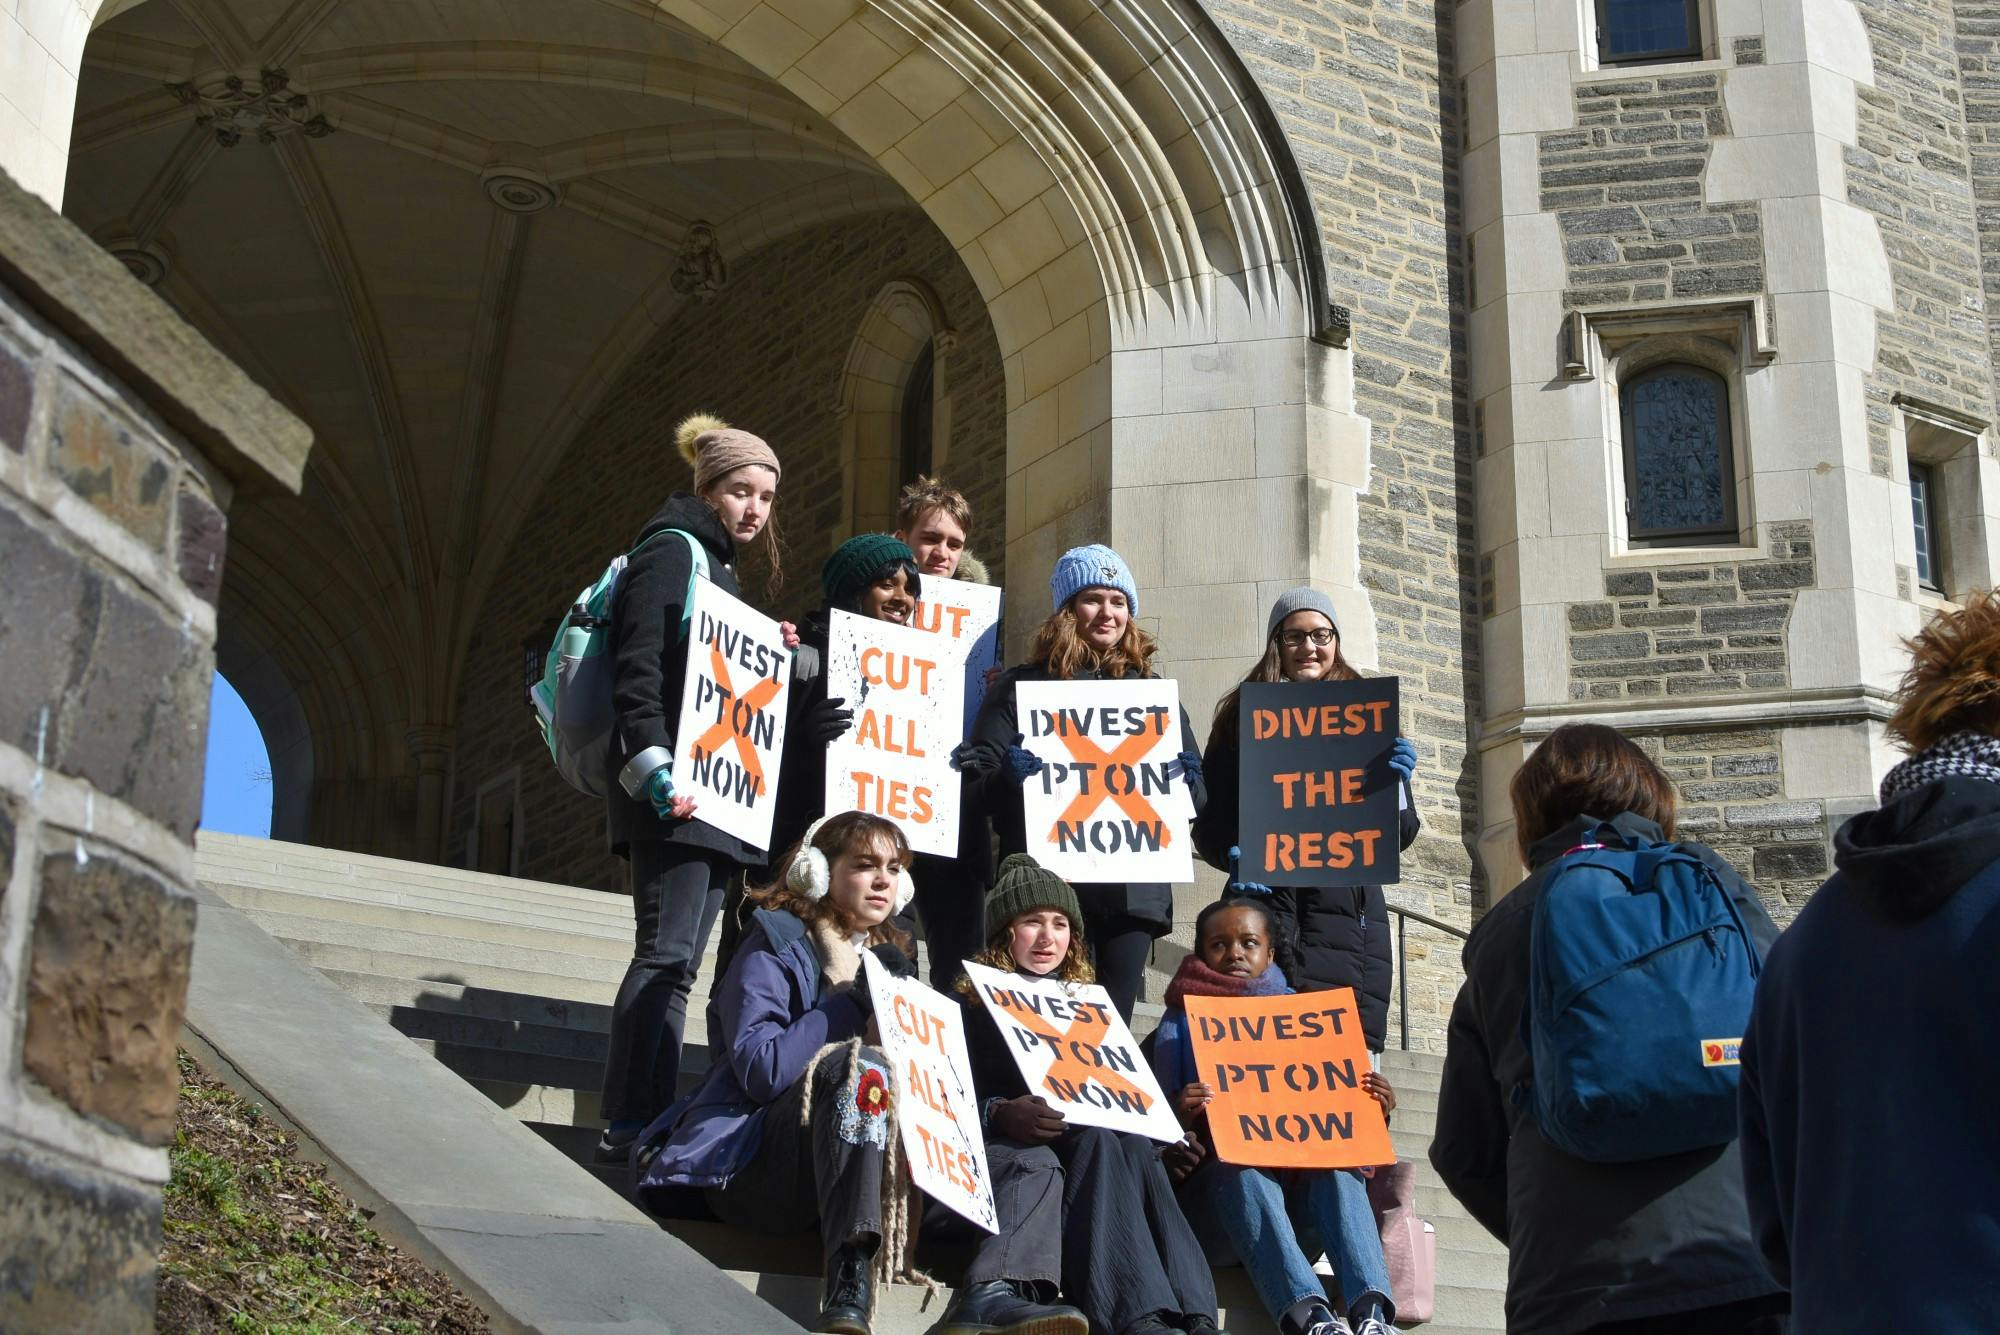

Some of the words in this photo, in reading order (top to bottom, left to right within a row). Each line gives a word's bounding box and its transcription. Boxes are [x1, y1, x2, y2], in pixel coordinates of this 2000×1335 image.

[915, 601, 970, 638] UT
[699, 611, 785, 684] DIVEST
[860, 647, 936, 695] CUT
[695, 674, 775, 751] PTON
[855, 709, 925, 758] ALL
[1030, 705, 1169, 738] DIVEST
[1253, 701, 1391, 740] DIVEST
[692, 745, 760, 809] NOW
[850, 771, 933, 825] TIES
[1042, 761, 1171, 796] PTON
[1273, 768, 1365, 809] THE
[1057, 819, 1162, 854] NOW
[1264, 829, 1382, 872] REST
[893, 995, 946, 1056] CUT
[983, 983, 1109, 1026] DIVEST
[1198, 1007, 1348, 1043] DIVEST
[1011, 1026, 1138, 1073] PTON
[908, 1058, 957, 1122] ALL
[1045, 1074, 1149, 1116] NOW
[1215, 1058, 1358, 1093] PTON
[1237, 1111, 1353, 1143] NOW
[915, 1123, 977, 1194] TIES
